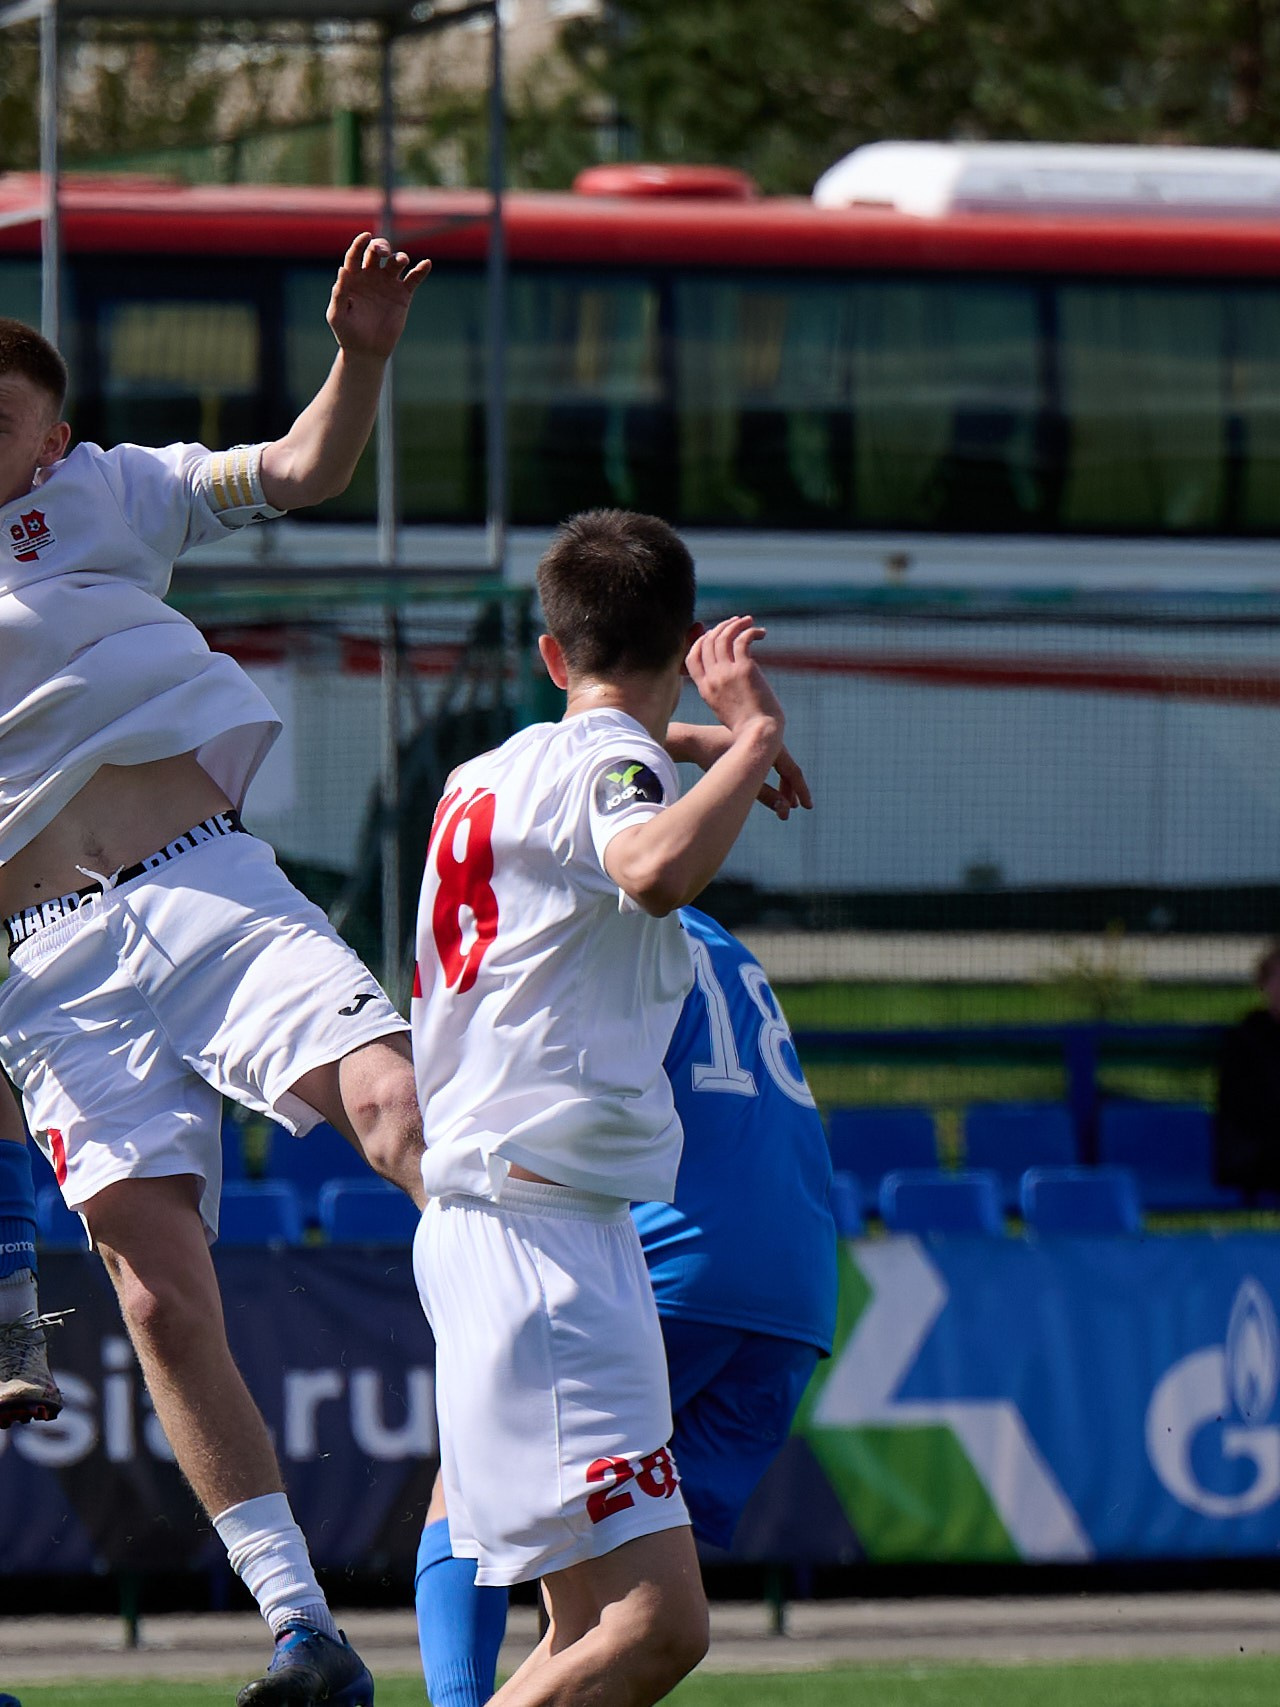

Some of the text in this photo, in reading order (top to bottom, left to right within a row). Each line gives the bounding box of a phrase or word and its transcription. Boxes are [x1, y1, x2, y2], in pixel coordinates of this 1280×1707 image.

[411, 786, 499, 995] 8
[686, 934, 816, 1109] 18
[586, 1446, 679, 1525] 28
